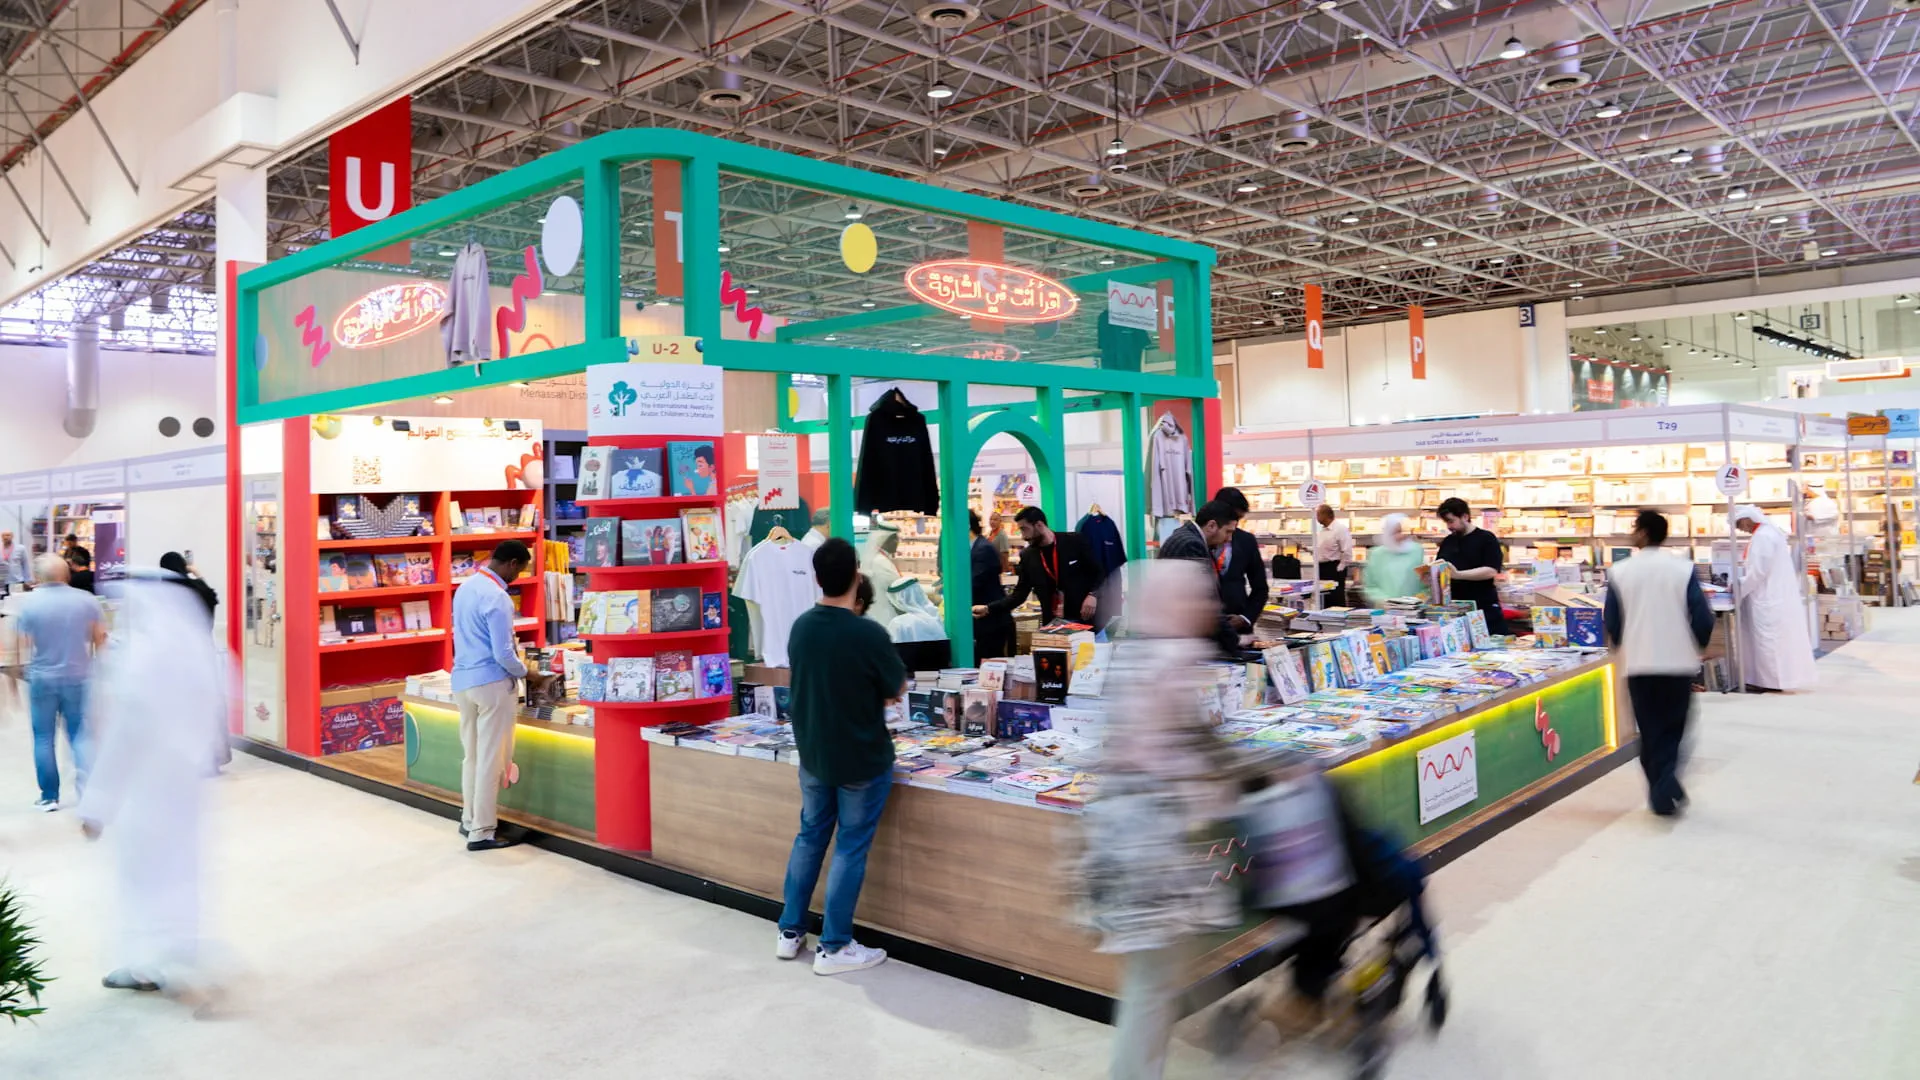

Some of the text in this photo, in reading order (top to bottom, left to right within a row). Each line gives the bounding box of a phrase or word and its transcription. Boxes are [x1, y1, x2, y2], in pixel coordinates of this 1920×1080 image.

[345, 155, 396, 221] U
[928, 272, 982, 305] الشارقة
[985, 283, 1008, 314] في
[1520, 308, 1531, 323] 3
[652, 342, 680, 355] U-2
[1308, 319, 1323, 351] Q
[1412, 335, 1425, 363] P
[520, 388, 567, 399] Menassah
[1656, 421, 1678, 431] T29
